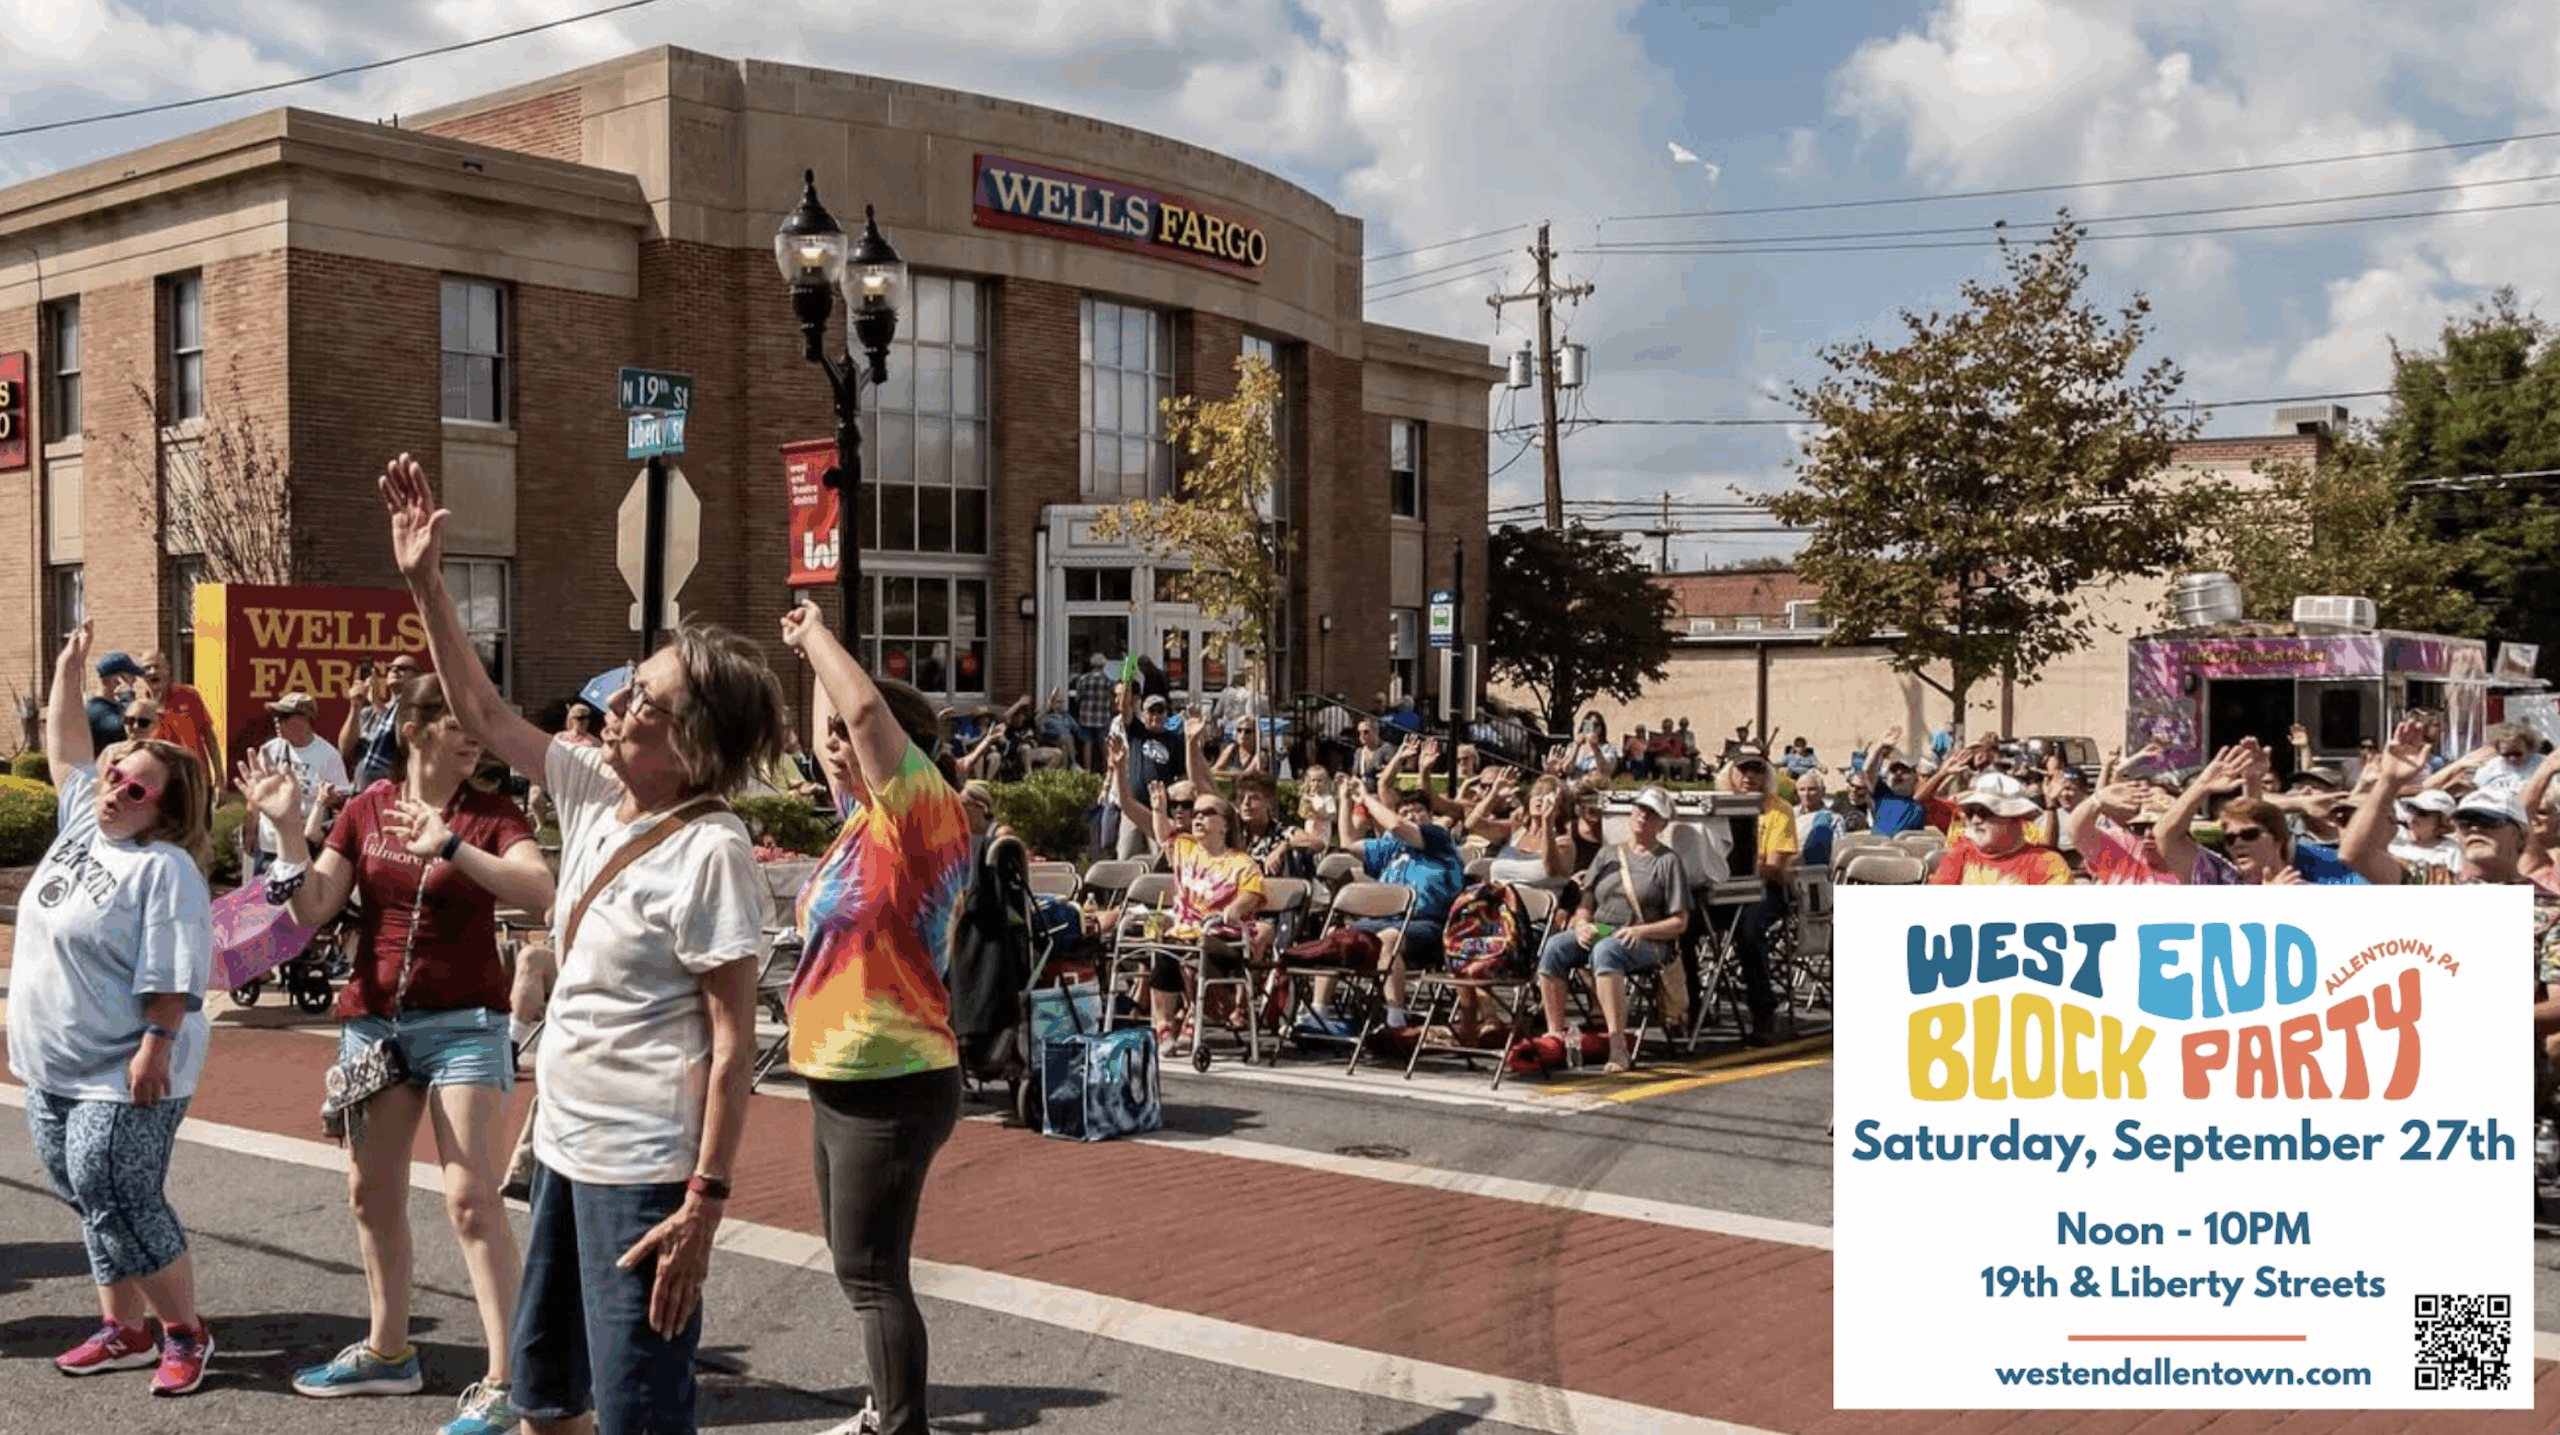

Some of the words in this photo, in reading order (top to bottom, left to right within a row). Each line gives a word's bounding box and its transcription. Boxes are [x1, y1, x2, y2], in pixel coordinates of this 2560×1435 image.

[990, 167, 1150, 237] WELLS
[1158, 202, 1268, 267] FARGO
[622, 380, 634, 405] N
[673, 386, 690, 411] St
[803, 528, 840, 571] W
[243, 606, 428, 653] WELLS
[249, 657, 390, 700] FAR
